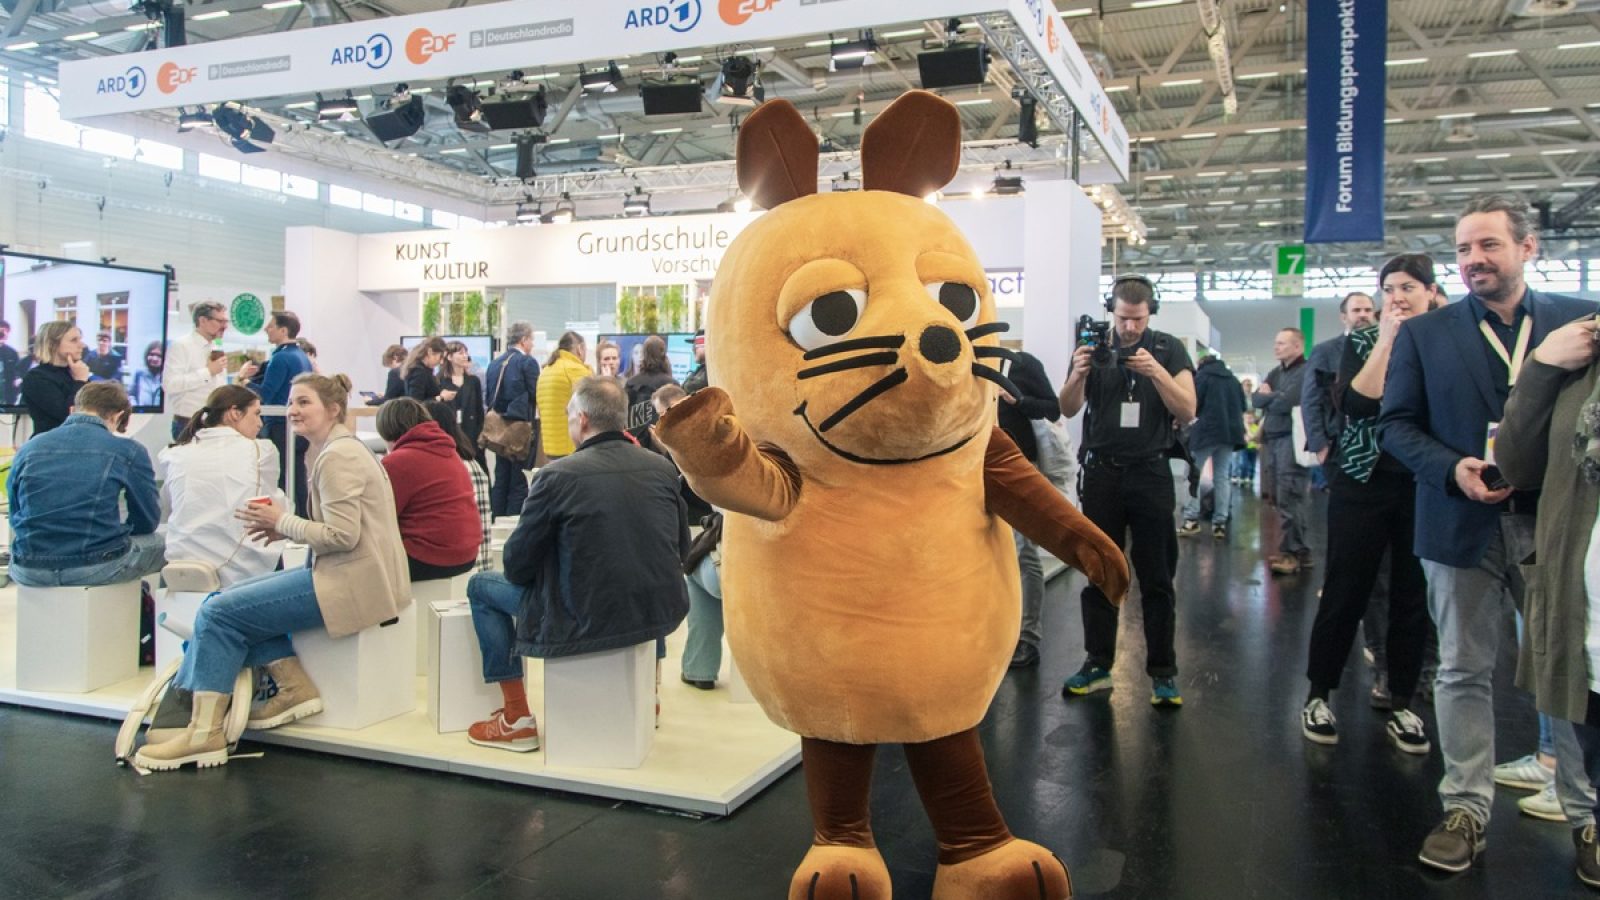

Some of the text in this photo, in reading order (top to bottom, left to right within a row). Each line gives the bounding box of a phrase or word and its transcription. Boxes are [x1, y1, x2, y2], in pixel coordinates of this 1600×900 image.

[624, 6, 669, 29] ARD
[331, 44, 367, 65] ARD
[421, 34, 456, 55] ZDF
[487, 22, 572, 42] Deutschlandradio
[97, 76, 126, 95] ARD
[169, 67, 199, 86] ZDF
[1335, 0, 1360, 212] Forum Bildungsperspekt
[395, 242, 451, 261] KUNST
[577, 224, 728, 254] Grundschule
[423, 261, 489, 280] KULTUR
[1286, 254, 1303, 275] 7
